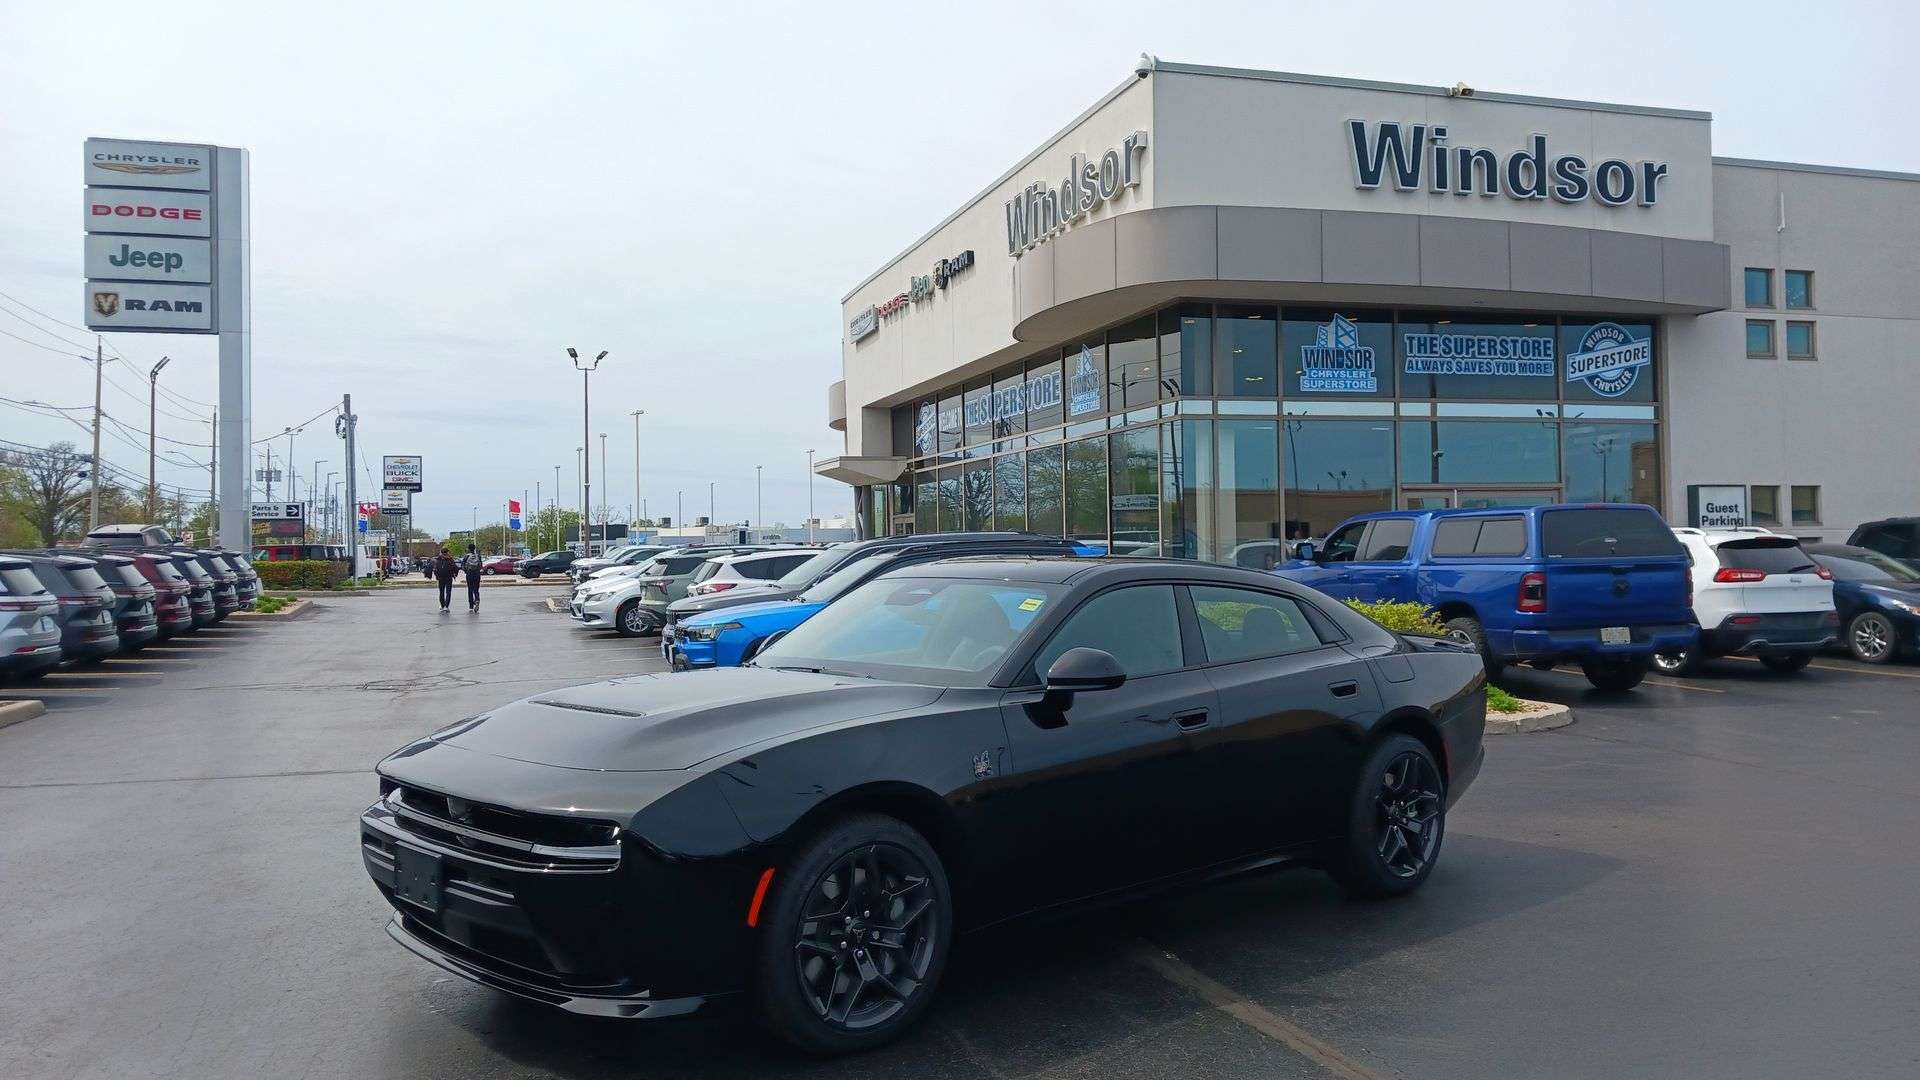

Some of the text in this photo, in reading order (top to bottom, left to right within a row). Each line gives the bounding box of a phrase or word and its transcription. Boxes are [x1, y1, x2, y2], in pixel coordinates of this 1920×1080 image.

[94, 153, 200, 166] CHRYSLER
[1345, 119, 1668, 207] Windsor
[1005, 131, 1147, 257] Windsor
[92, 204, 202, 220] DODGE
[109, 244, 183, 273] Jeep
[124, 299, 203, 313] RAM
[1406, 335, 1552, 358] THE SUPERSTORE
[1586, 327, 1625, 348] WINDSOR
[1303, 348, 1373, 369] WINDSOR
[1407, 358, 1452, 373] ALWAYS
[1455, 359, 1492, 374] SAVES
[1494, 360, 1516, 374] YOU
[1570, 346, 1648, 375] SUPERSTORE
[1303, 379, 1375, 389] SUPERSTORE
[1311, 370, 1367, 378] CHRYSLER
[1593, 370, 1632, 392] CHRYSLER
[980, 371, 1061, 424] SUPERSTORE
[1706, 502, 1739, 513] Guest
[1701, 515, 1744, 527] Parking
